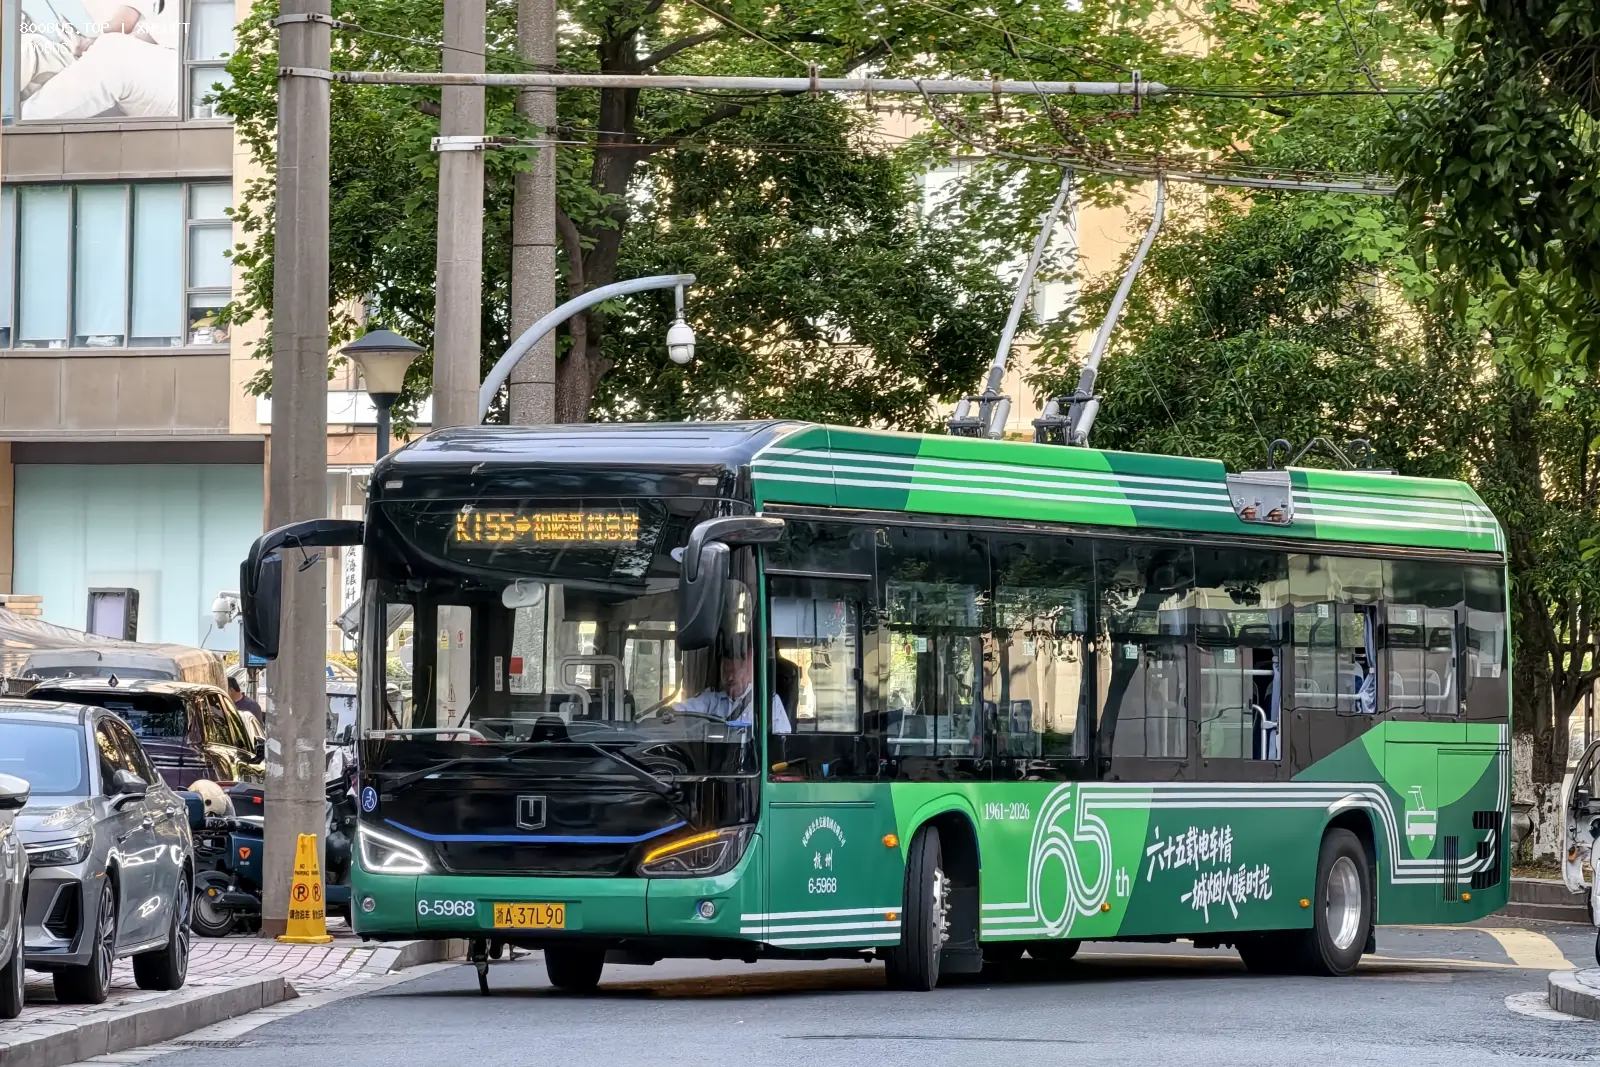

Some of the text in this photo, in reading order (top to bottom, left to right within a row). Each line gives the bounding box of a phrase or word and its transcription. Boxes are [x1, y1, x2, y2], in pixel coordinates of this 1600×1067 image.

[456, 512, 515, 541] K155
[984, 803, 1030, 820] 1961-2026
[813, 849, 833, 872] 杭州
[1146, 825, 1234, 882] 六十五载电车情
[808, 877, 837, 894] 6-5968
[1180, 862, 1273, 924] 一城烟火暖时光
[417, 900, 475, 917] 6-5968
